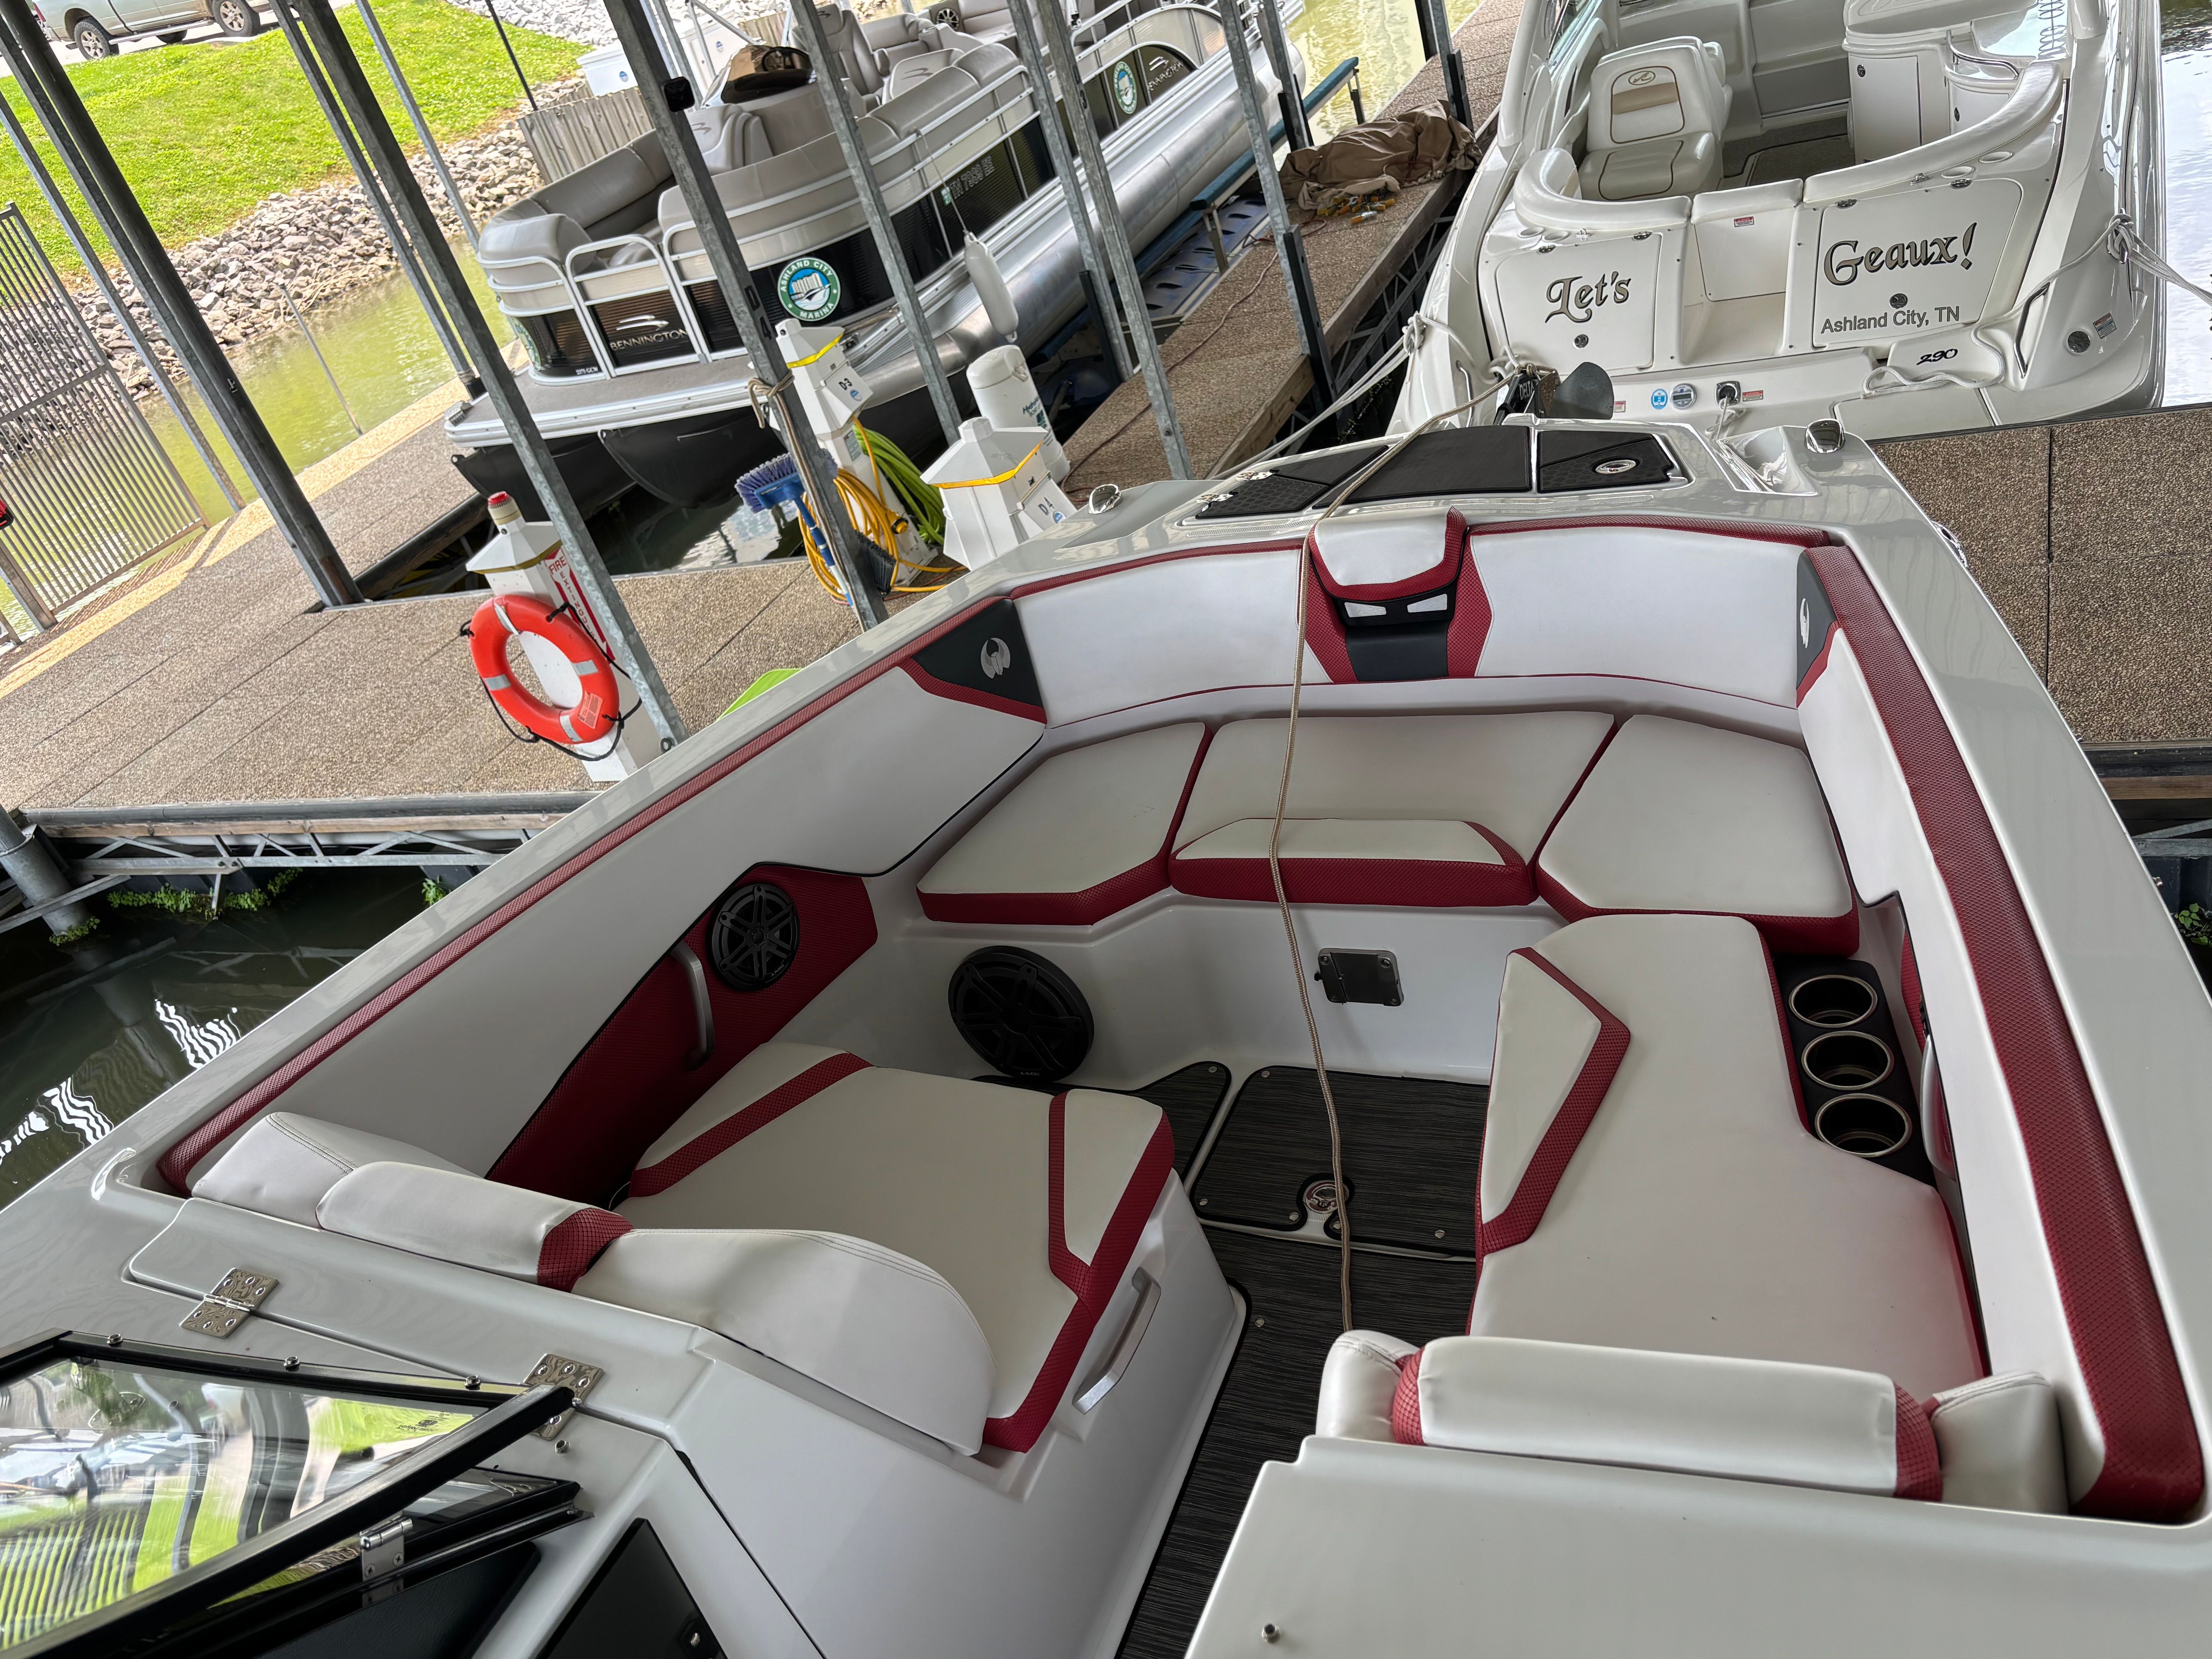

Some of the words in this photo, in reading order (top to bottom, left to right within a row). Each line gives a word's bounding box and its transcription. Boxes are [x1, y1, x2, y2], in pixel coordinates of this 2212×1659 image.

[1147, 61, 1184, 91] ENNINGTON
[1824, 222, 1977, 286] Geaux!
[780, 260, 810, 292] ASHLAND
[813, 261, 833, 276] CITY
[800, 302, 834, 319] MARINA
[1545, 271, 1632, 323] Let's
[1821, 312, 1887, 334] Ashland
[1893, 310, 1929, 327] City,
[1934, 306, 1960, 322] TN
[1917, 349, 1958, 365] 290
[549, 556, 567, 575] FIRE
